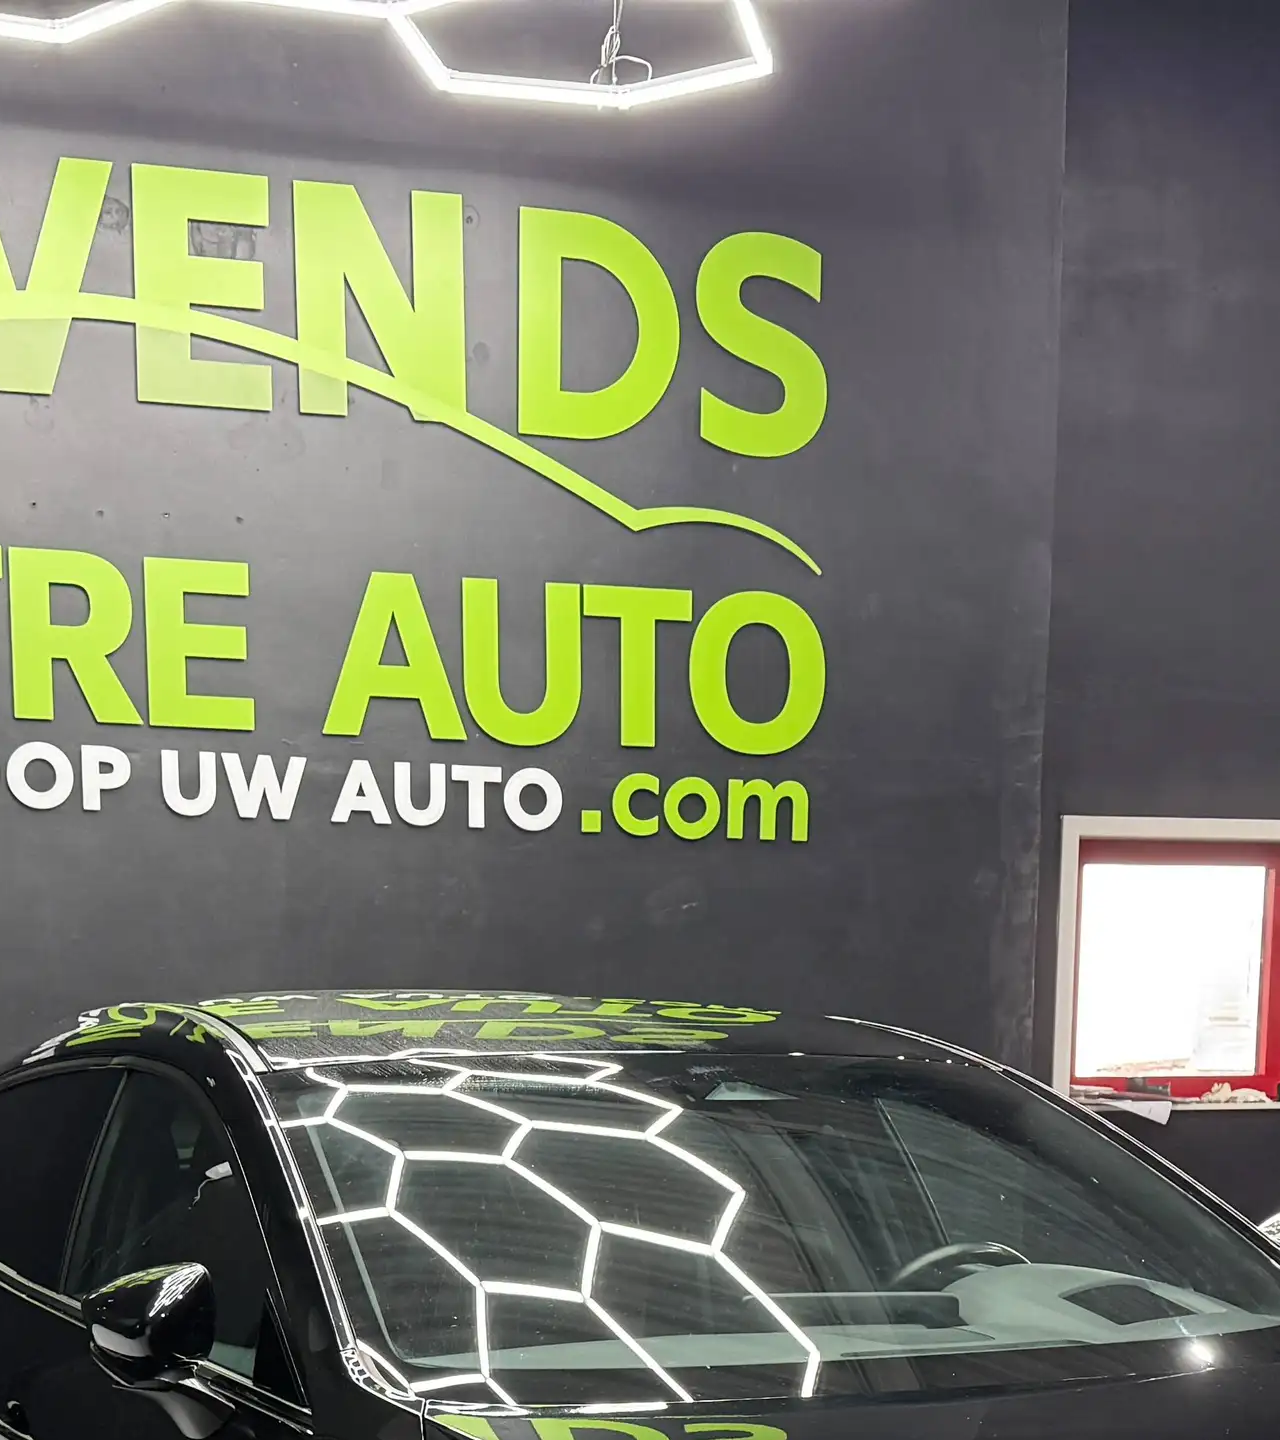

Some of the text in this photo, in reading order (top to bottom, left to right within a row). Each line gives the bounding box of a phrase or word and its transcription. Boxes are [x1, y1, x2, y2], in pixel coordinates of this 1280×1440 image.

[322, 571, 827, 756] AUTO
[160, 748, 308, 822] UW
[330, 759, 563, 832] AUTO
[580, 772, 809, 842] .com
